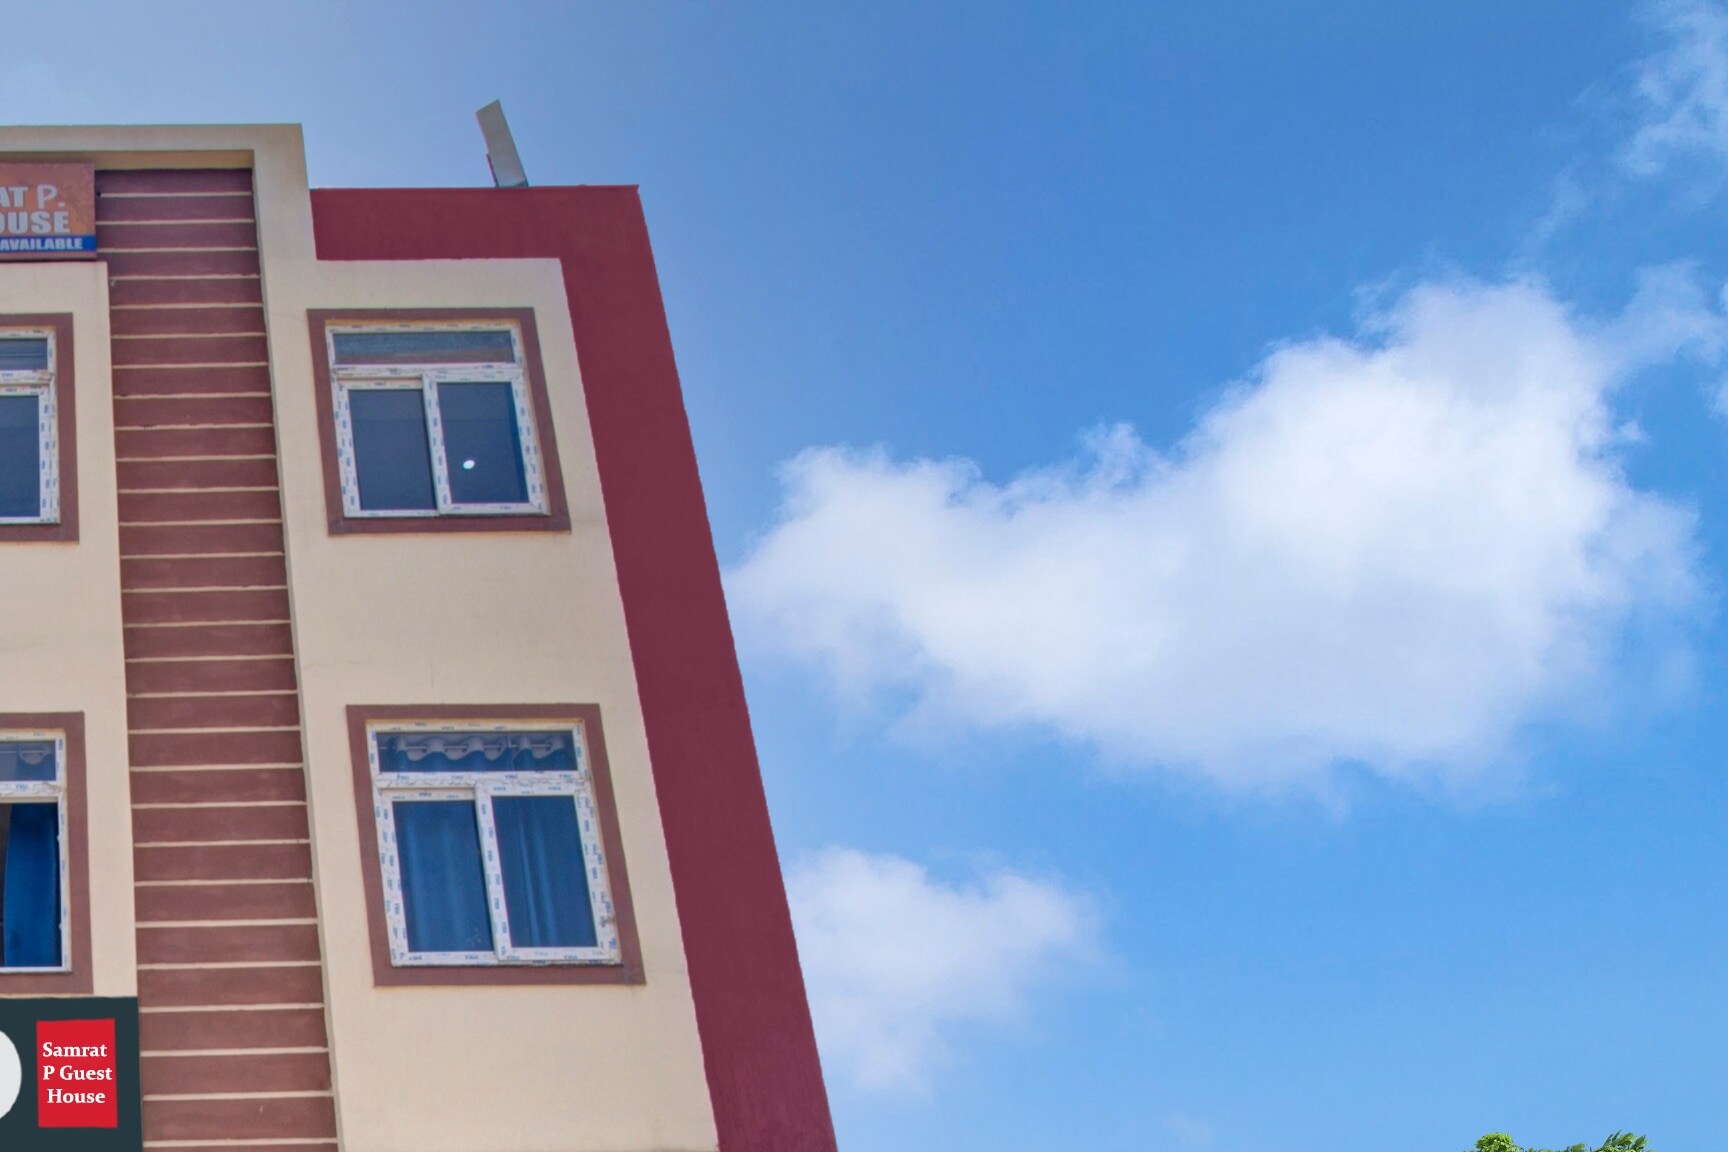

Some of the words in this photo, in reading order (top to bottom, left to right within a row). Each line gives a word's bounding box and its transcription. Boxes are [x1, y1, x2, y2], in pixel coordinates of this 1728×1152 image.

[37, 184, 65, 209] P.
[0, 237, 83, 250] AVAILABLE
[42, 1042, 107, 1058] Samrat
[43, 1066, 54, 1081] P
[59, 1066, 112, 1081] Guest
[47, 1089, 106, 1104] House
